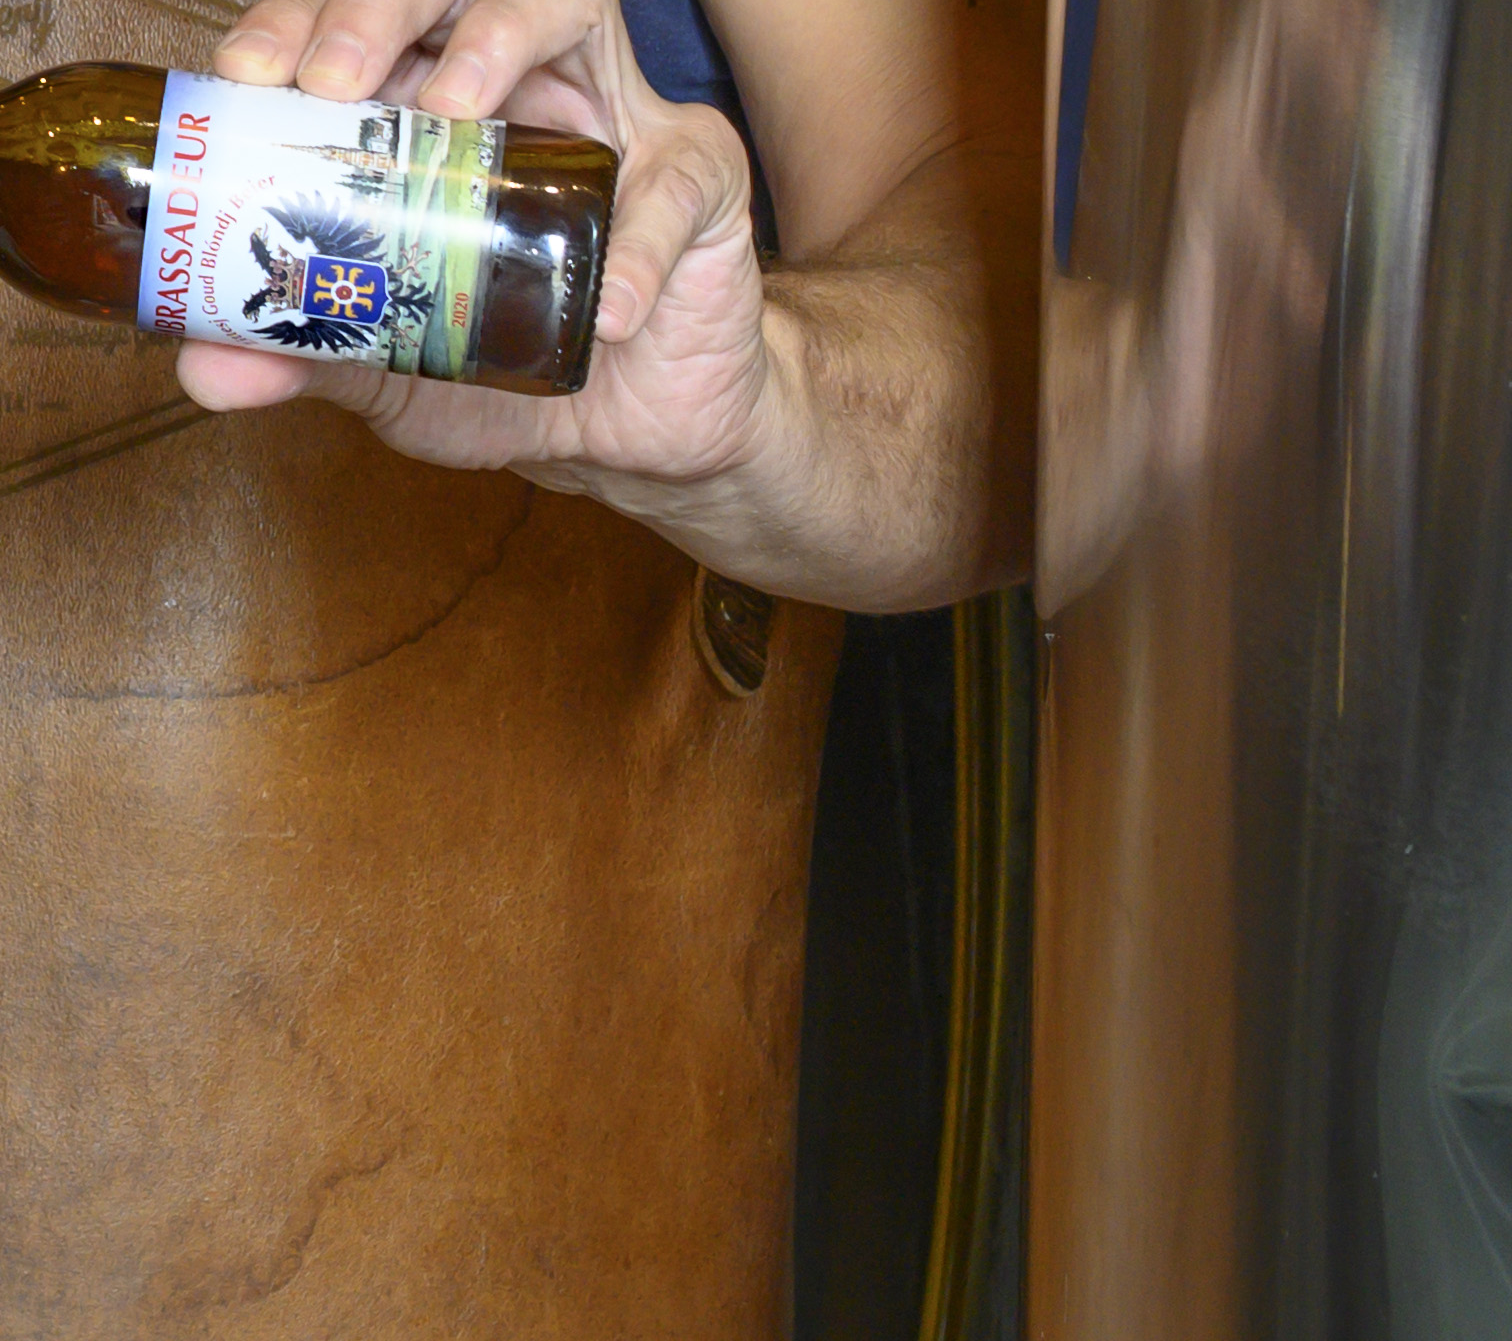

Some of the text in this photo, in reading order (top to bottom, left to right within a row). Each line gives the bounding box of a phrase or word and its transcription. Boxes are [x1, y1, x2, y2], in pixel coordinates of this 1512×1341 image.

[153, 113, 211, 335] BRASSADEUR
[200, 210, 238, 270] Blóndj
[201, 275, 219, 316] Goud
[451, 292, 470, 329] 2020
